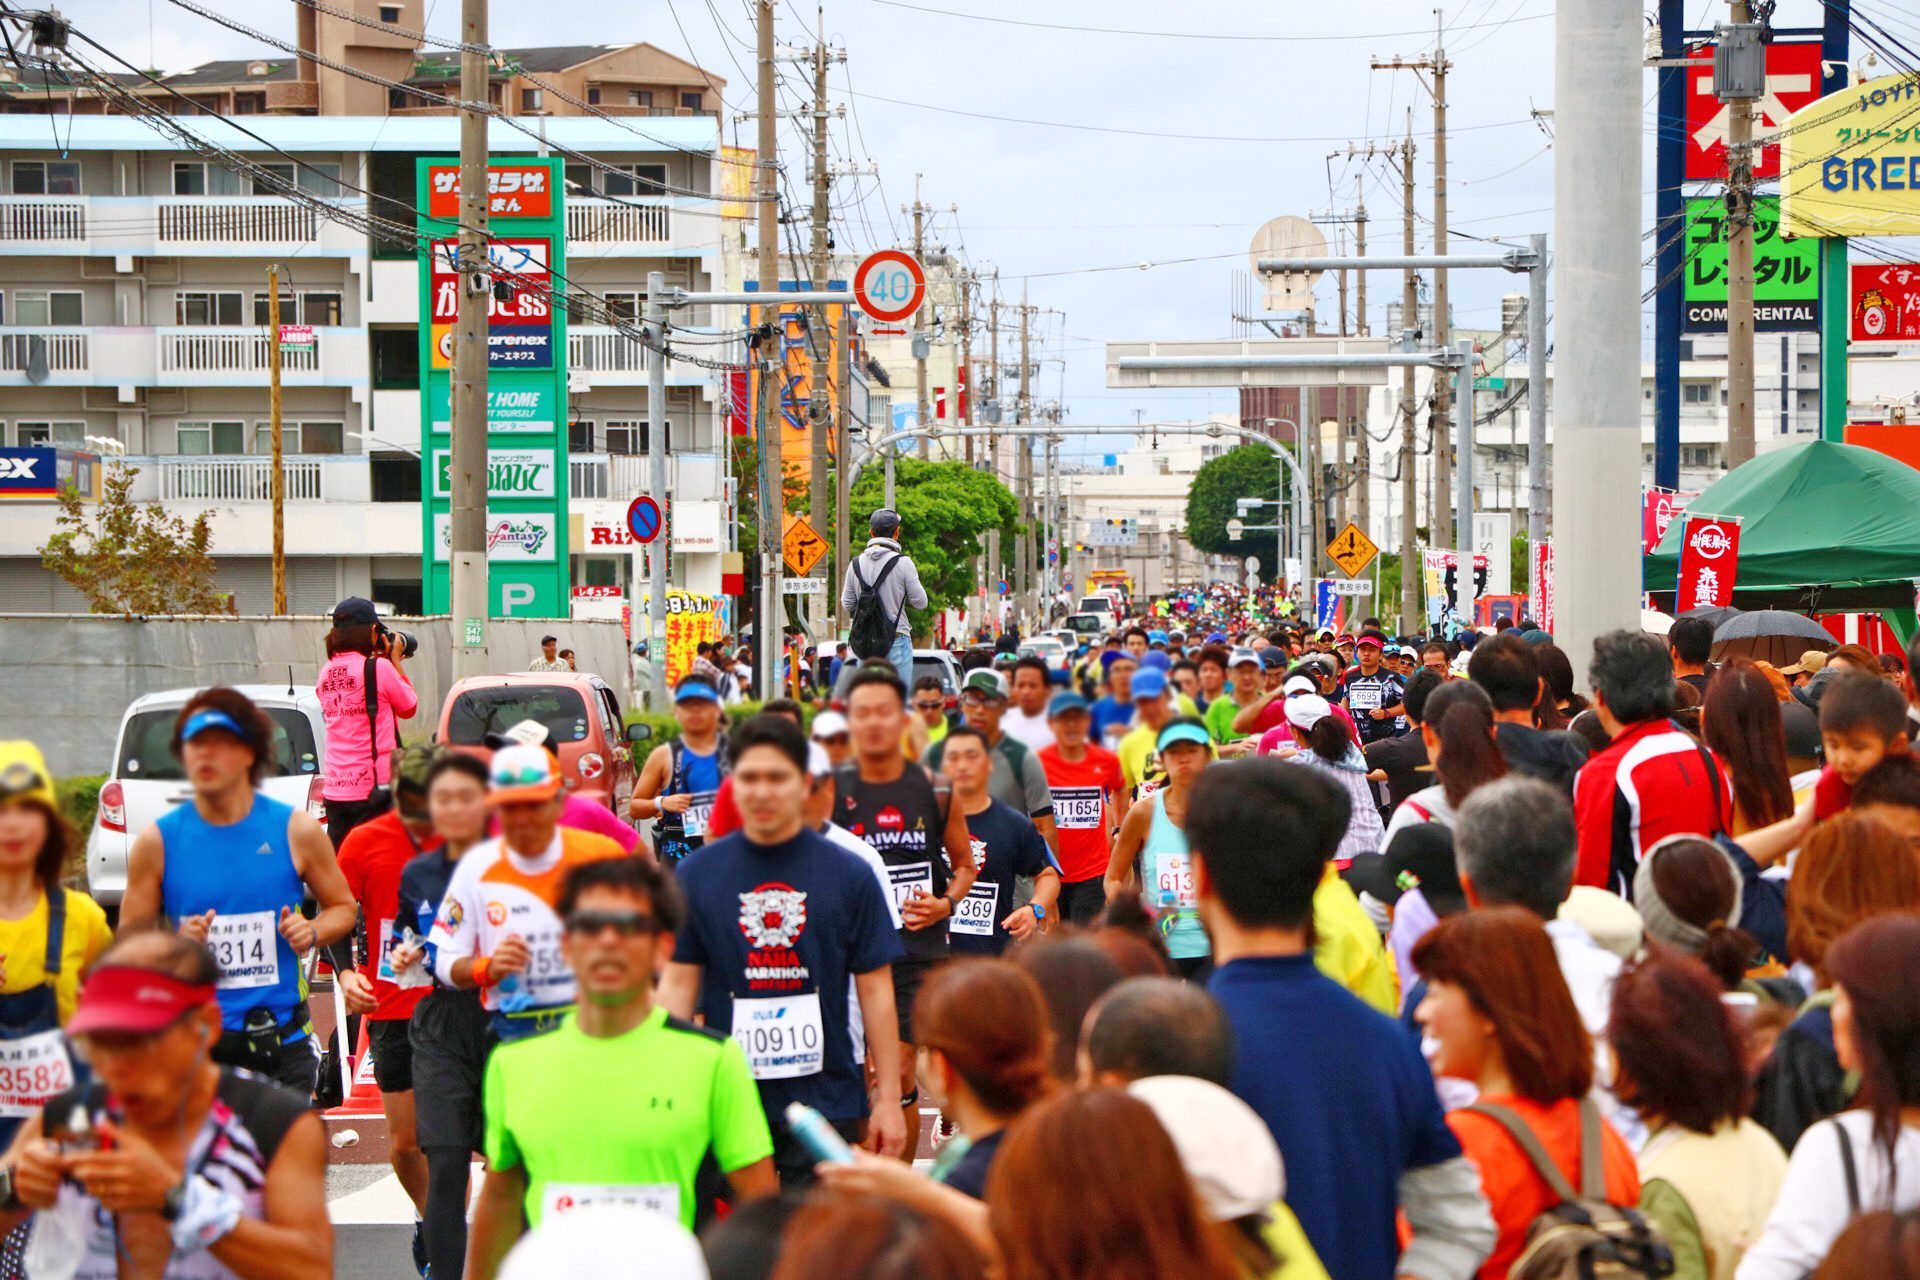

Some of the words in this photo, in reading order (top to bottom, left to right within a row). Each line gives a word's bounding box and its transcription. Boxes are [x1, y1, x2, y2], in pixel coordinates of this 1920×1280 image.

[1860, 81, 1920, 112] JOYF
[434, 172, 545, 194] サプラザ
[1692, 216, 1801, 244] コッ
[871, 271, 909, 302] 40
[1689, 308, 1728, 322] COM
[1753, 307, 1814, 321] RENTAL
[487, 335, 549, 346] arenex
[490, 351, 536, 361] カーエネクス
[495, 392, 541, 407] HOME
[496, 410, 537, 418] YOURSELF
[1445, 556, 1485, 567] domo
[578, 587, 616, 597] レギュラー
[784, 581, 819, 592] 事故多発
[1338, 583, 1370, 592] 事故多発
[502, 583, 536, 617] P
[466, 627, 482, 635] 547
[465, 635, 481, 643] 999
[1356, 691, 1377, 701] 6695
[863, 831, 926, 846] AIWAN
